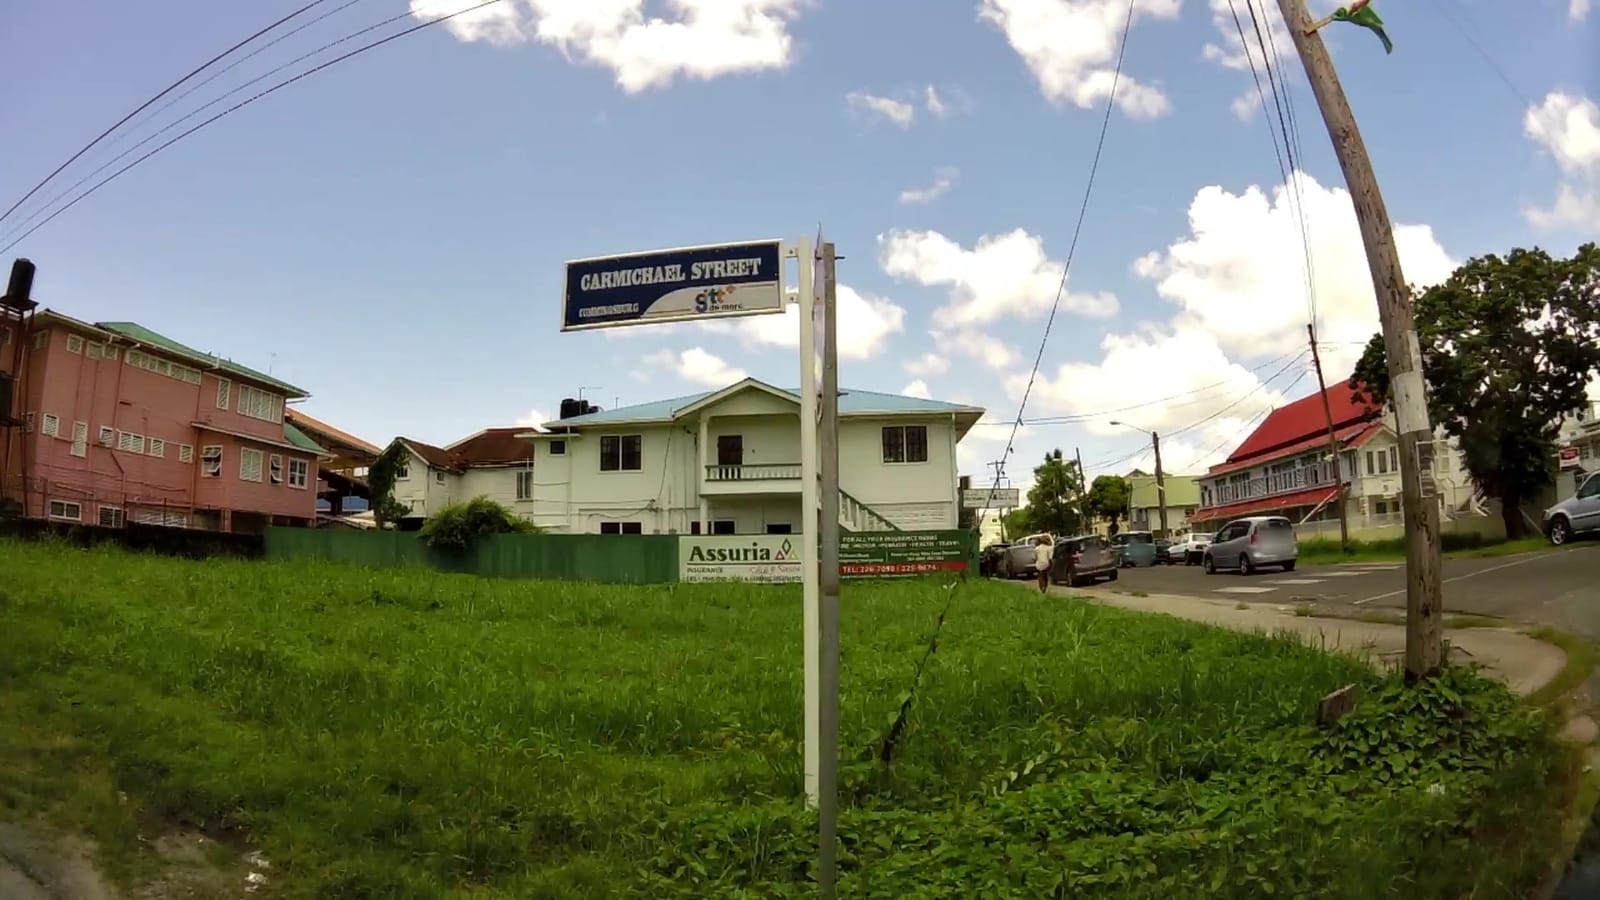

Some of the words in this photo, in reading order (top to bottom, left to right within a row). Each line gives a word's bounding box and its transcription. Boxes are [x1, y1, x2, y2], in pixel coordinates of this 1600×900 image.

[580, 264, 686, 291] CARMICHAEL
[690, 257, 762, 280] STREET
[689, 542, 770, 561] Assuria
